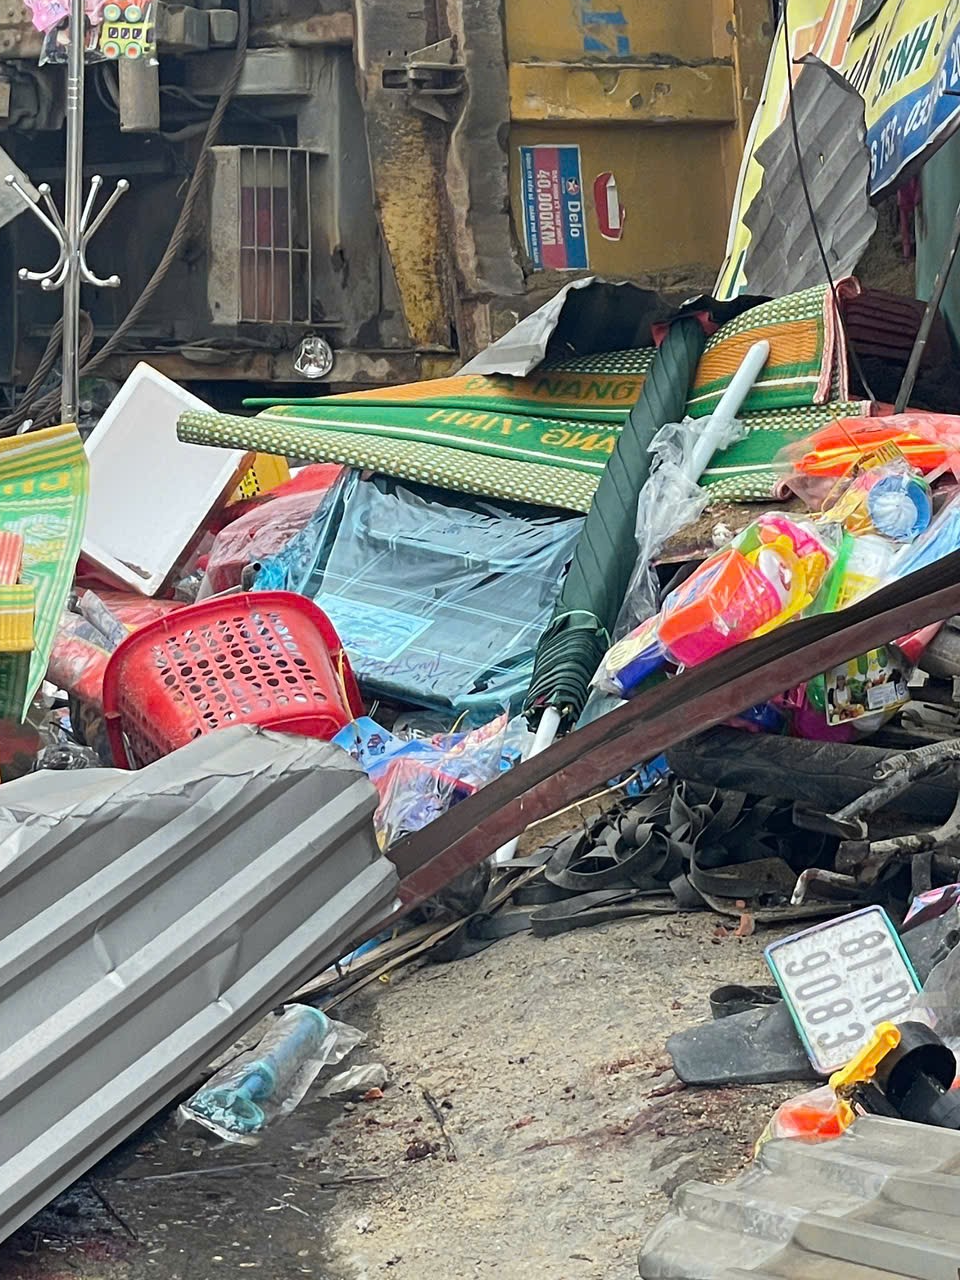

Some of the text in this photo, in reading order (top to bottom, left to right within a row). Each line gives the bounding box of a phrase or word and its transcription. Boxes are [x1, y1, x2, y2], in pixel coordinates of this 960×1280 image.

[872, 13, 939, 107] SINH
[567, 200, 582, 238] Delo
[785, 951, 866, 1049] 9083
